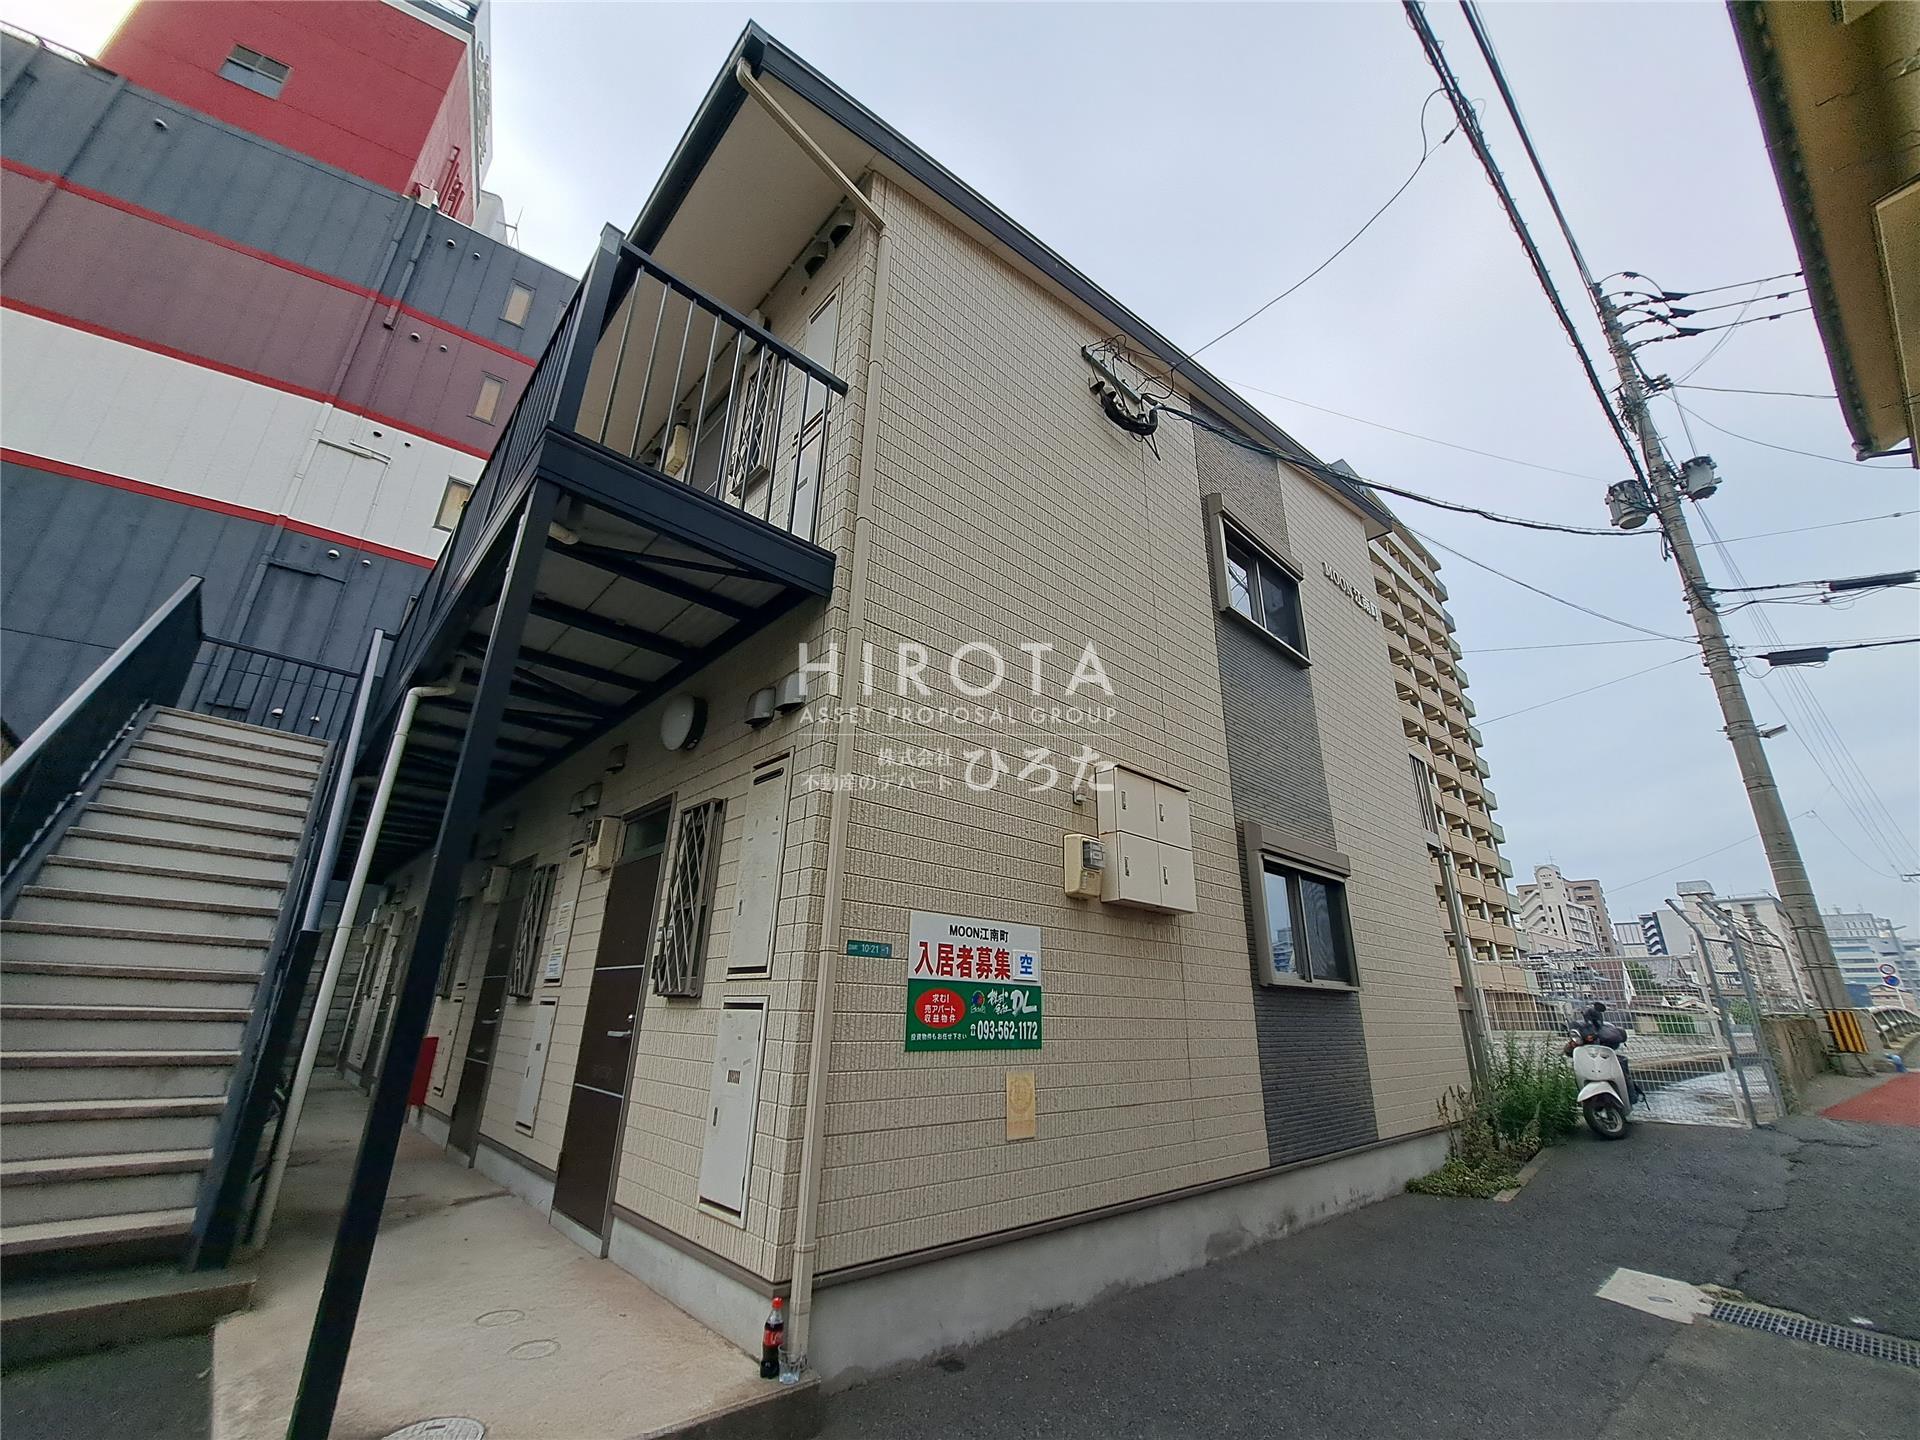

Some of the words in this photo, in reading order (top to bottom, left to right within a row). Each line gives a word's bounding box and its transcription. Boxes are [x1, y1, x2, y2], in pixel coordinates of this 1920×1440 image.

[949, 924, 1009, 943] MOON江南町
[914, 941, 1011, 979] 入居者募集
[1019, 953, 1033, 975] 空
